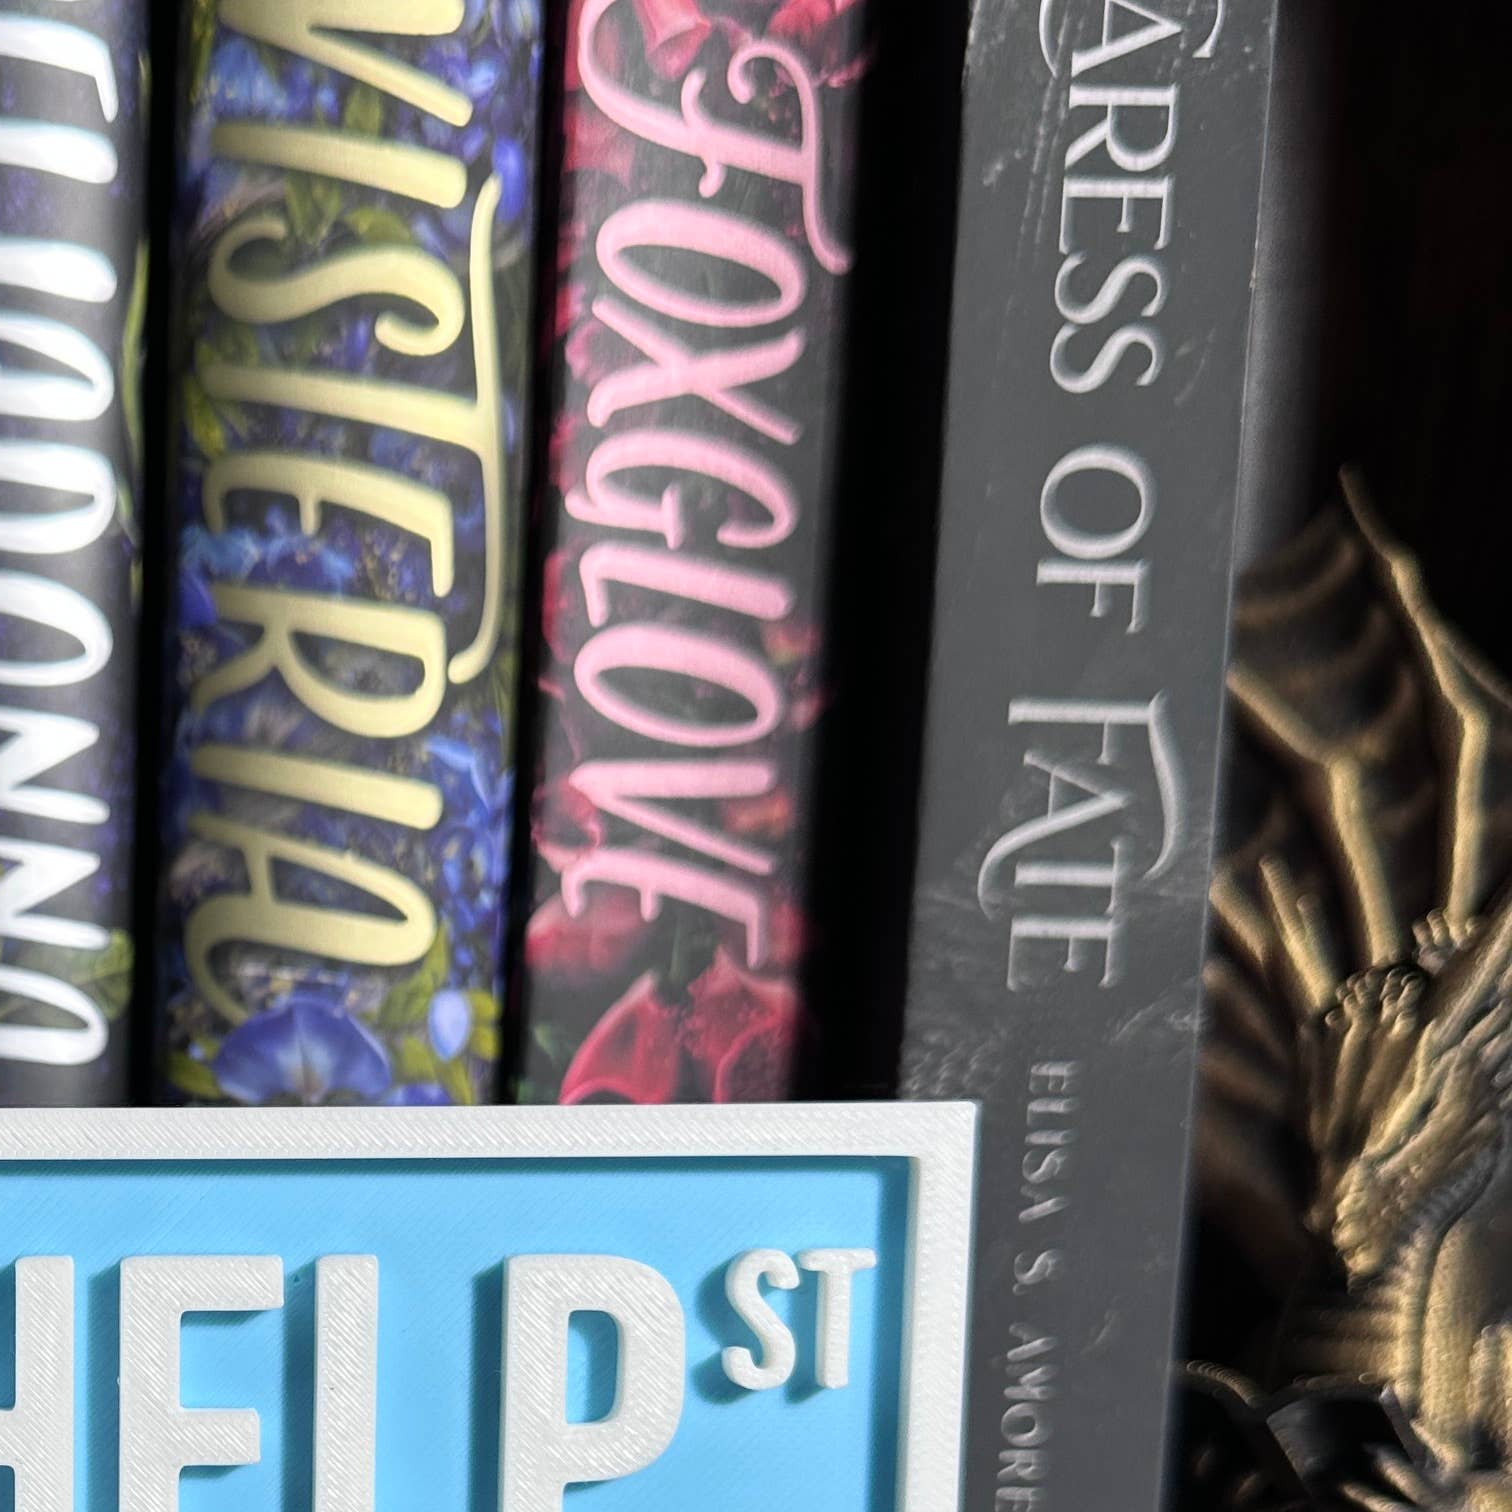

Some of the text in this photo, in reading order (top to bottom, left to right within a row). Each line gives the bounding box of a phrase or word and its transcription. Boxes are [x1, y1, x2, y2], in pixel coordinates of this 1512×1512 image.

[560, 0, 856, 970] FOXGLOVE
[1034, 443, 1156, 636] OF
[976, 688, 1191, 992] FATE
[1018, 1060, 1081, 1223] ELISA
[721, 1246, 878, 1391] ST
